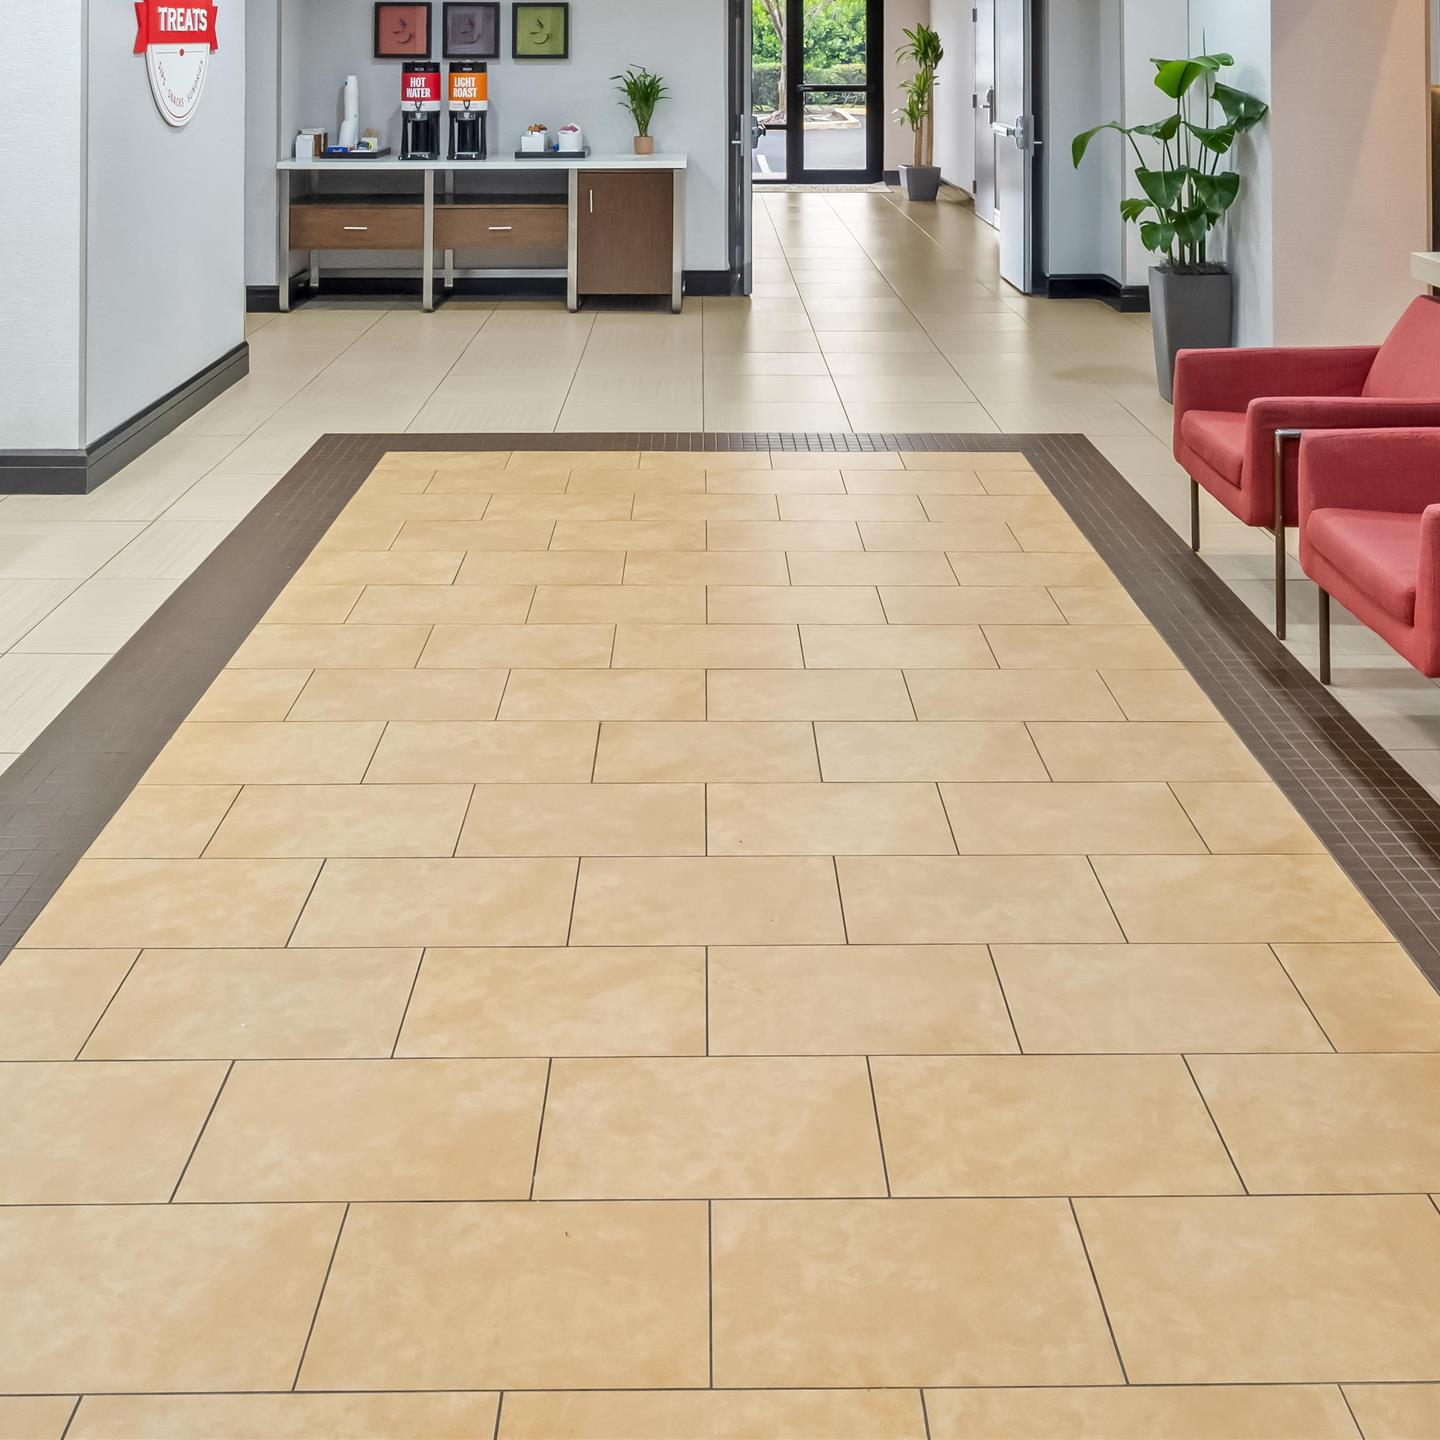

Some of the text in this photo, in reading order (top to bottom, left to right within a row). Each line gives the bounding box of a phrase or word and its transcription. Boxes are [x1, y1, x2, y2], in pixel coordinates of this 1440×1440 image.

[157, 6, 208, 32] TREATS
[410, 77, 426, 87] HOT
[454, 77, 476, 87] LIGHT
[406, 88, 431, 98] WATER
[453, 88, 478, 98] ROAST
